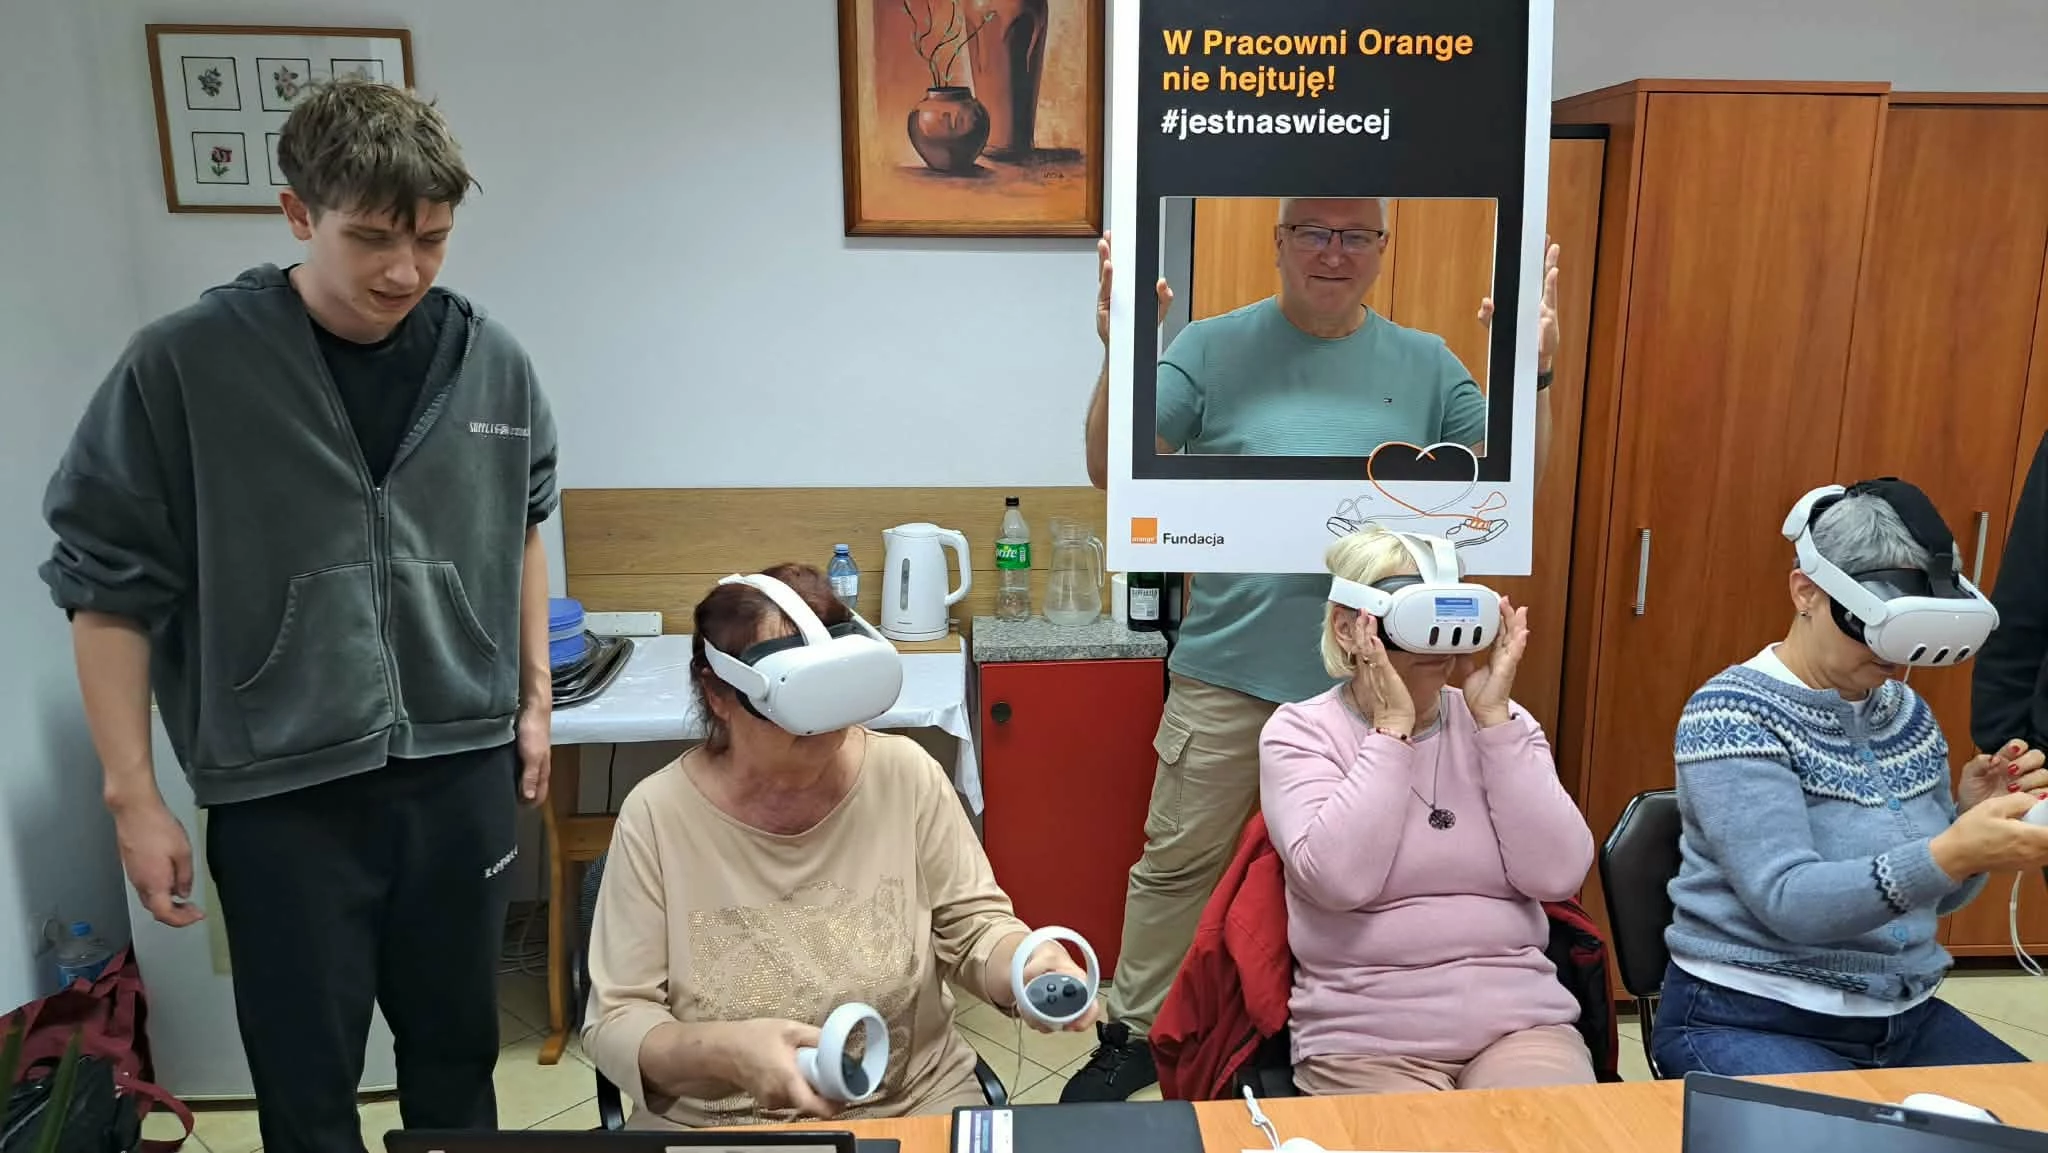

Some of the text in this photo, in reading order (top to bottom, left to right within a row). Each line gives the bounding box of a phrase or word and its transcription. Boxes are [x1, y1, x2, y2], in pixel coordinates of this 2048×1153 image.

[1162, 28, 1474, 61] W Pracowni Orange
[1163, 65, 1335, 97] nie hejtuję!
[1160, 108, 1390, 140] #jestnaswiecej
[1163, 533, 1224, 546] Fundacja
